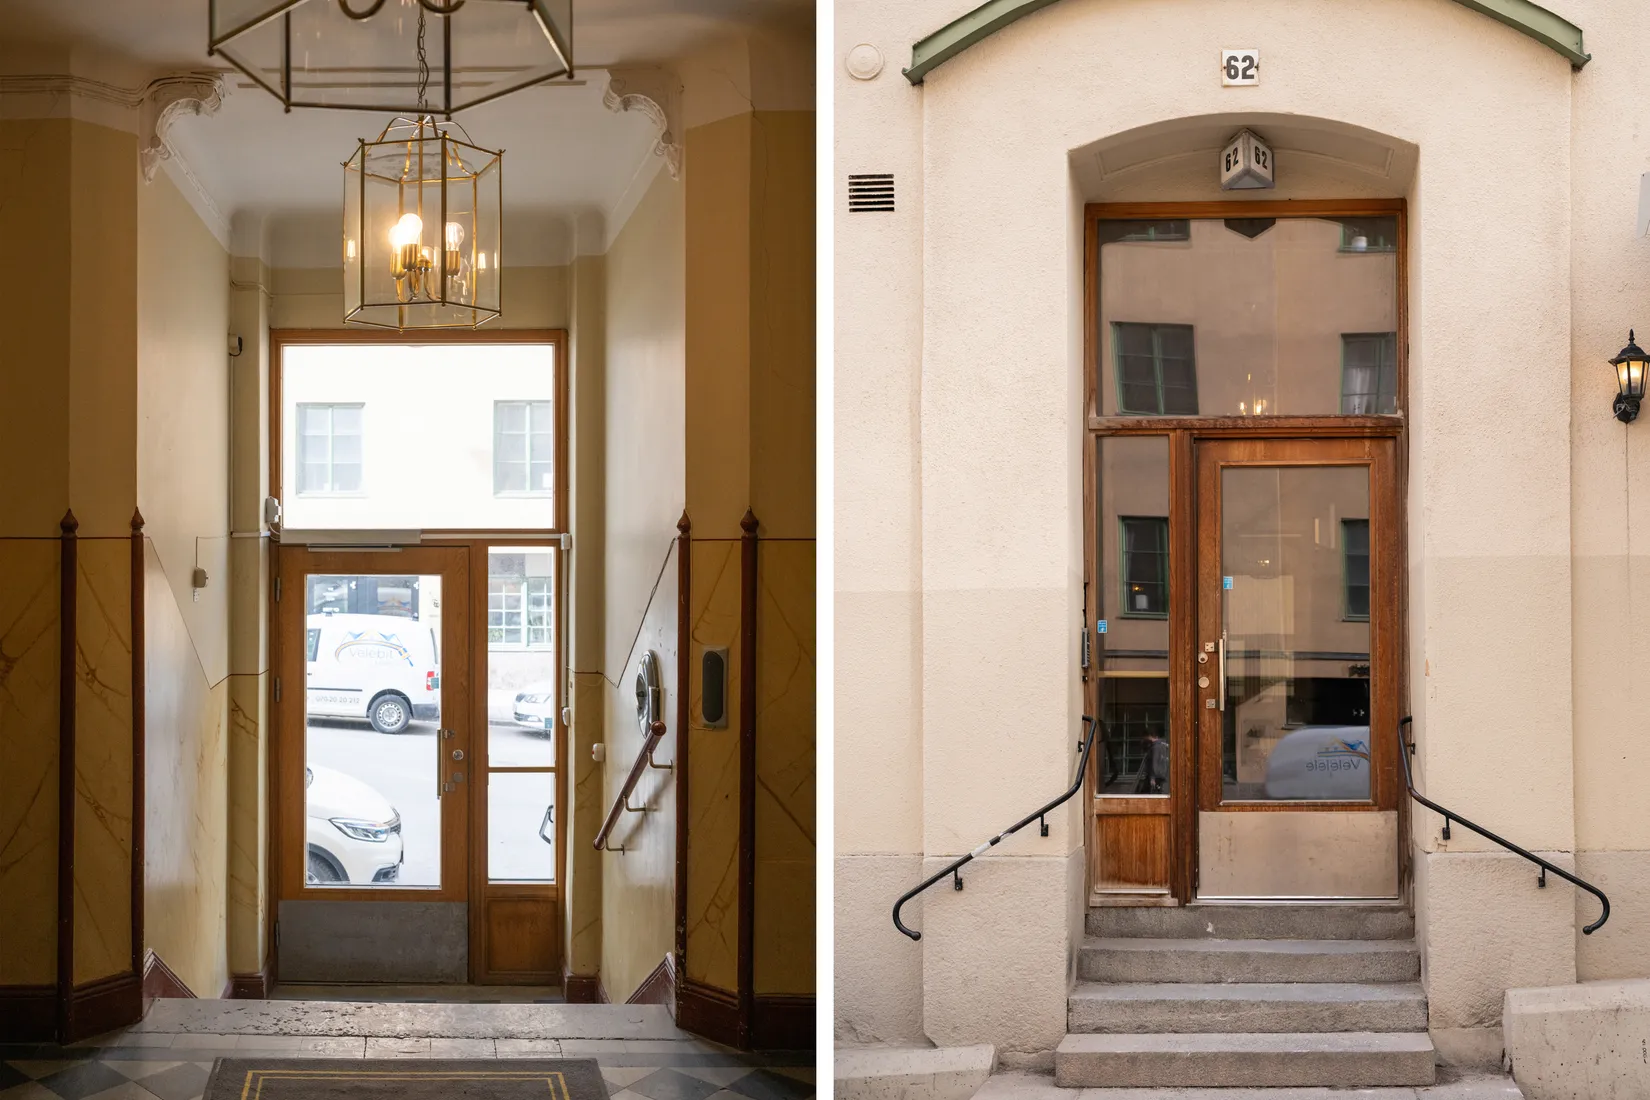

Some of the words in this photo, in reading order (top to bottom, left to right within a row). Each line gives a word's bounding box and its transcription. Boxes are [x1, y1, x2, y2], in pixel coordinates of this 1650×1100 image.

[1226, 55, 1255, 80] 62
[1225, 147, 1239, 172] 62
[1254, 146, 1268, 170] 62
[349, 647, 394, 659] Velebit
